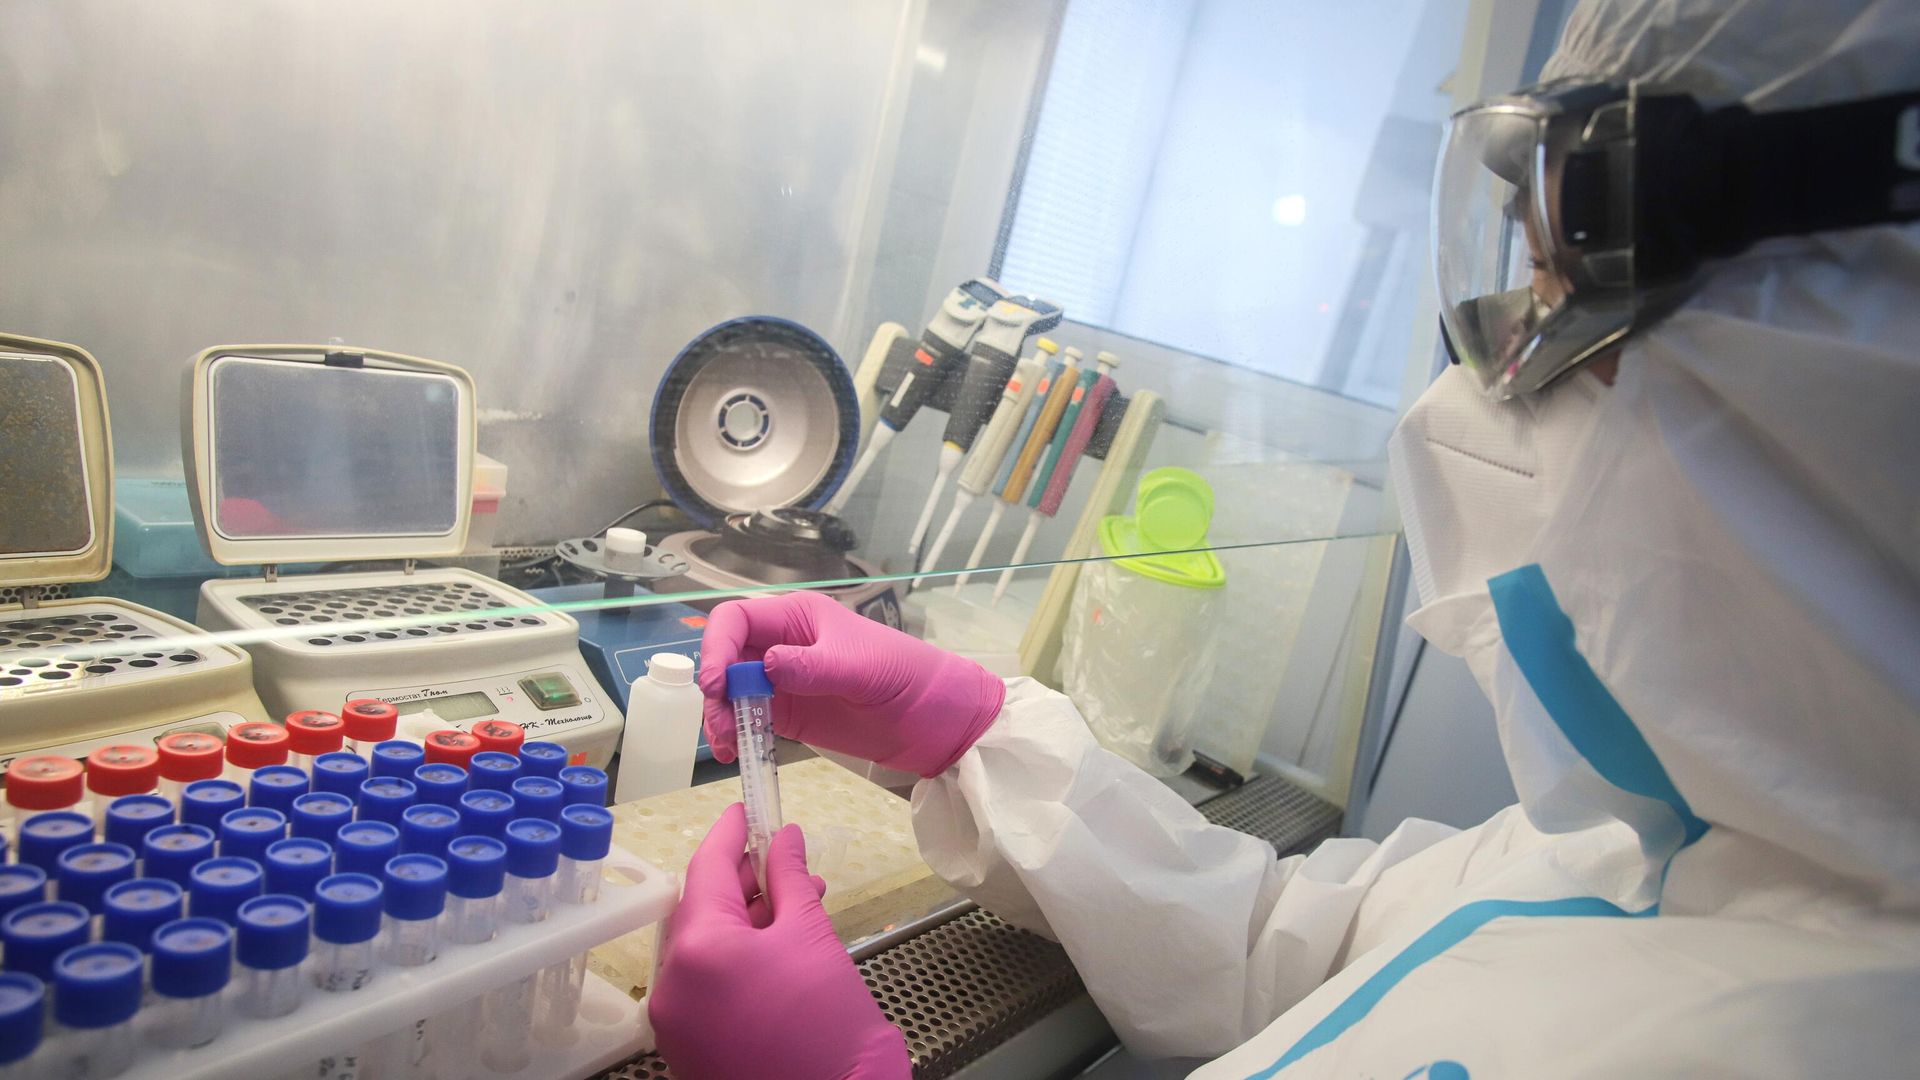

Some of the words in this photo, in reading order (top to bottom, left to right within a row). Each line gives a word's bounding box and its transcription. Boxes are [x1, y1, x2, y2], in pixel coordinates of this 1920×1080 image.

[752, 707, 763, 716] 10
[519, 714, 593, 730] НК-Технология
[755, 718, 762, 727] 9
[757, 734, 764, 743] 8
[759, 749, 765, 759] 7
